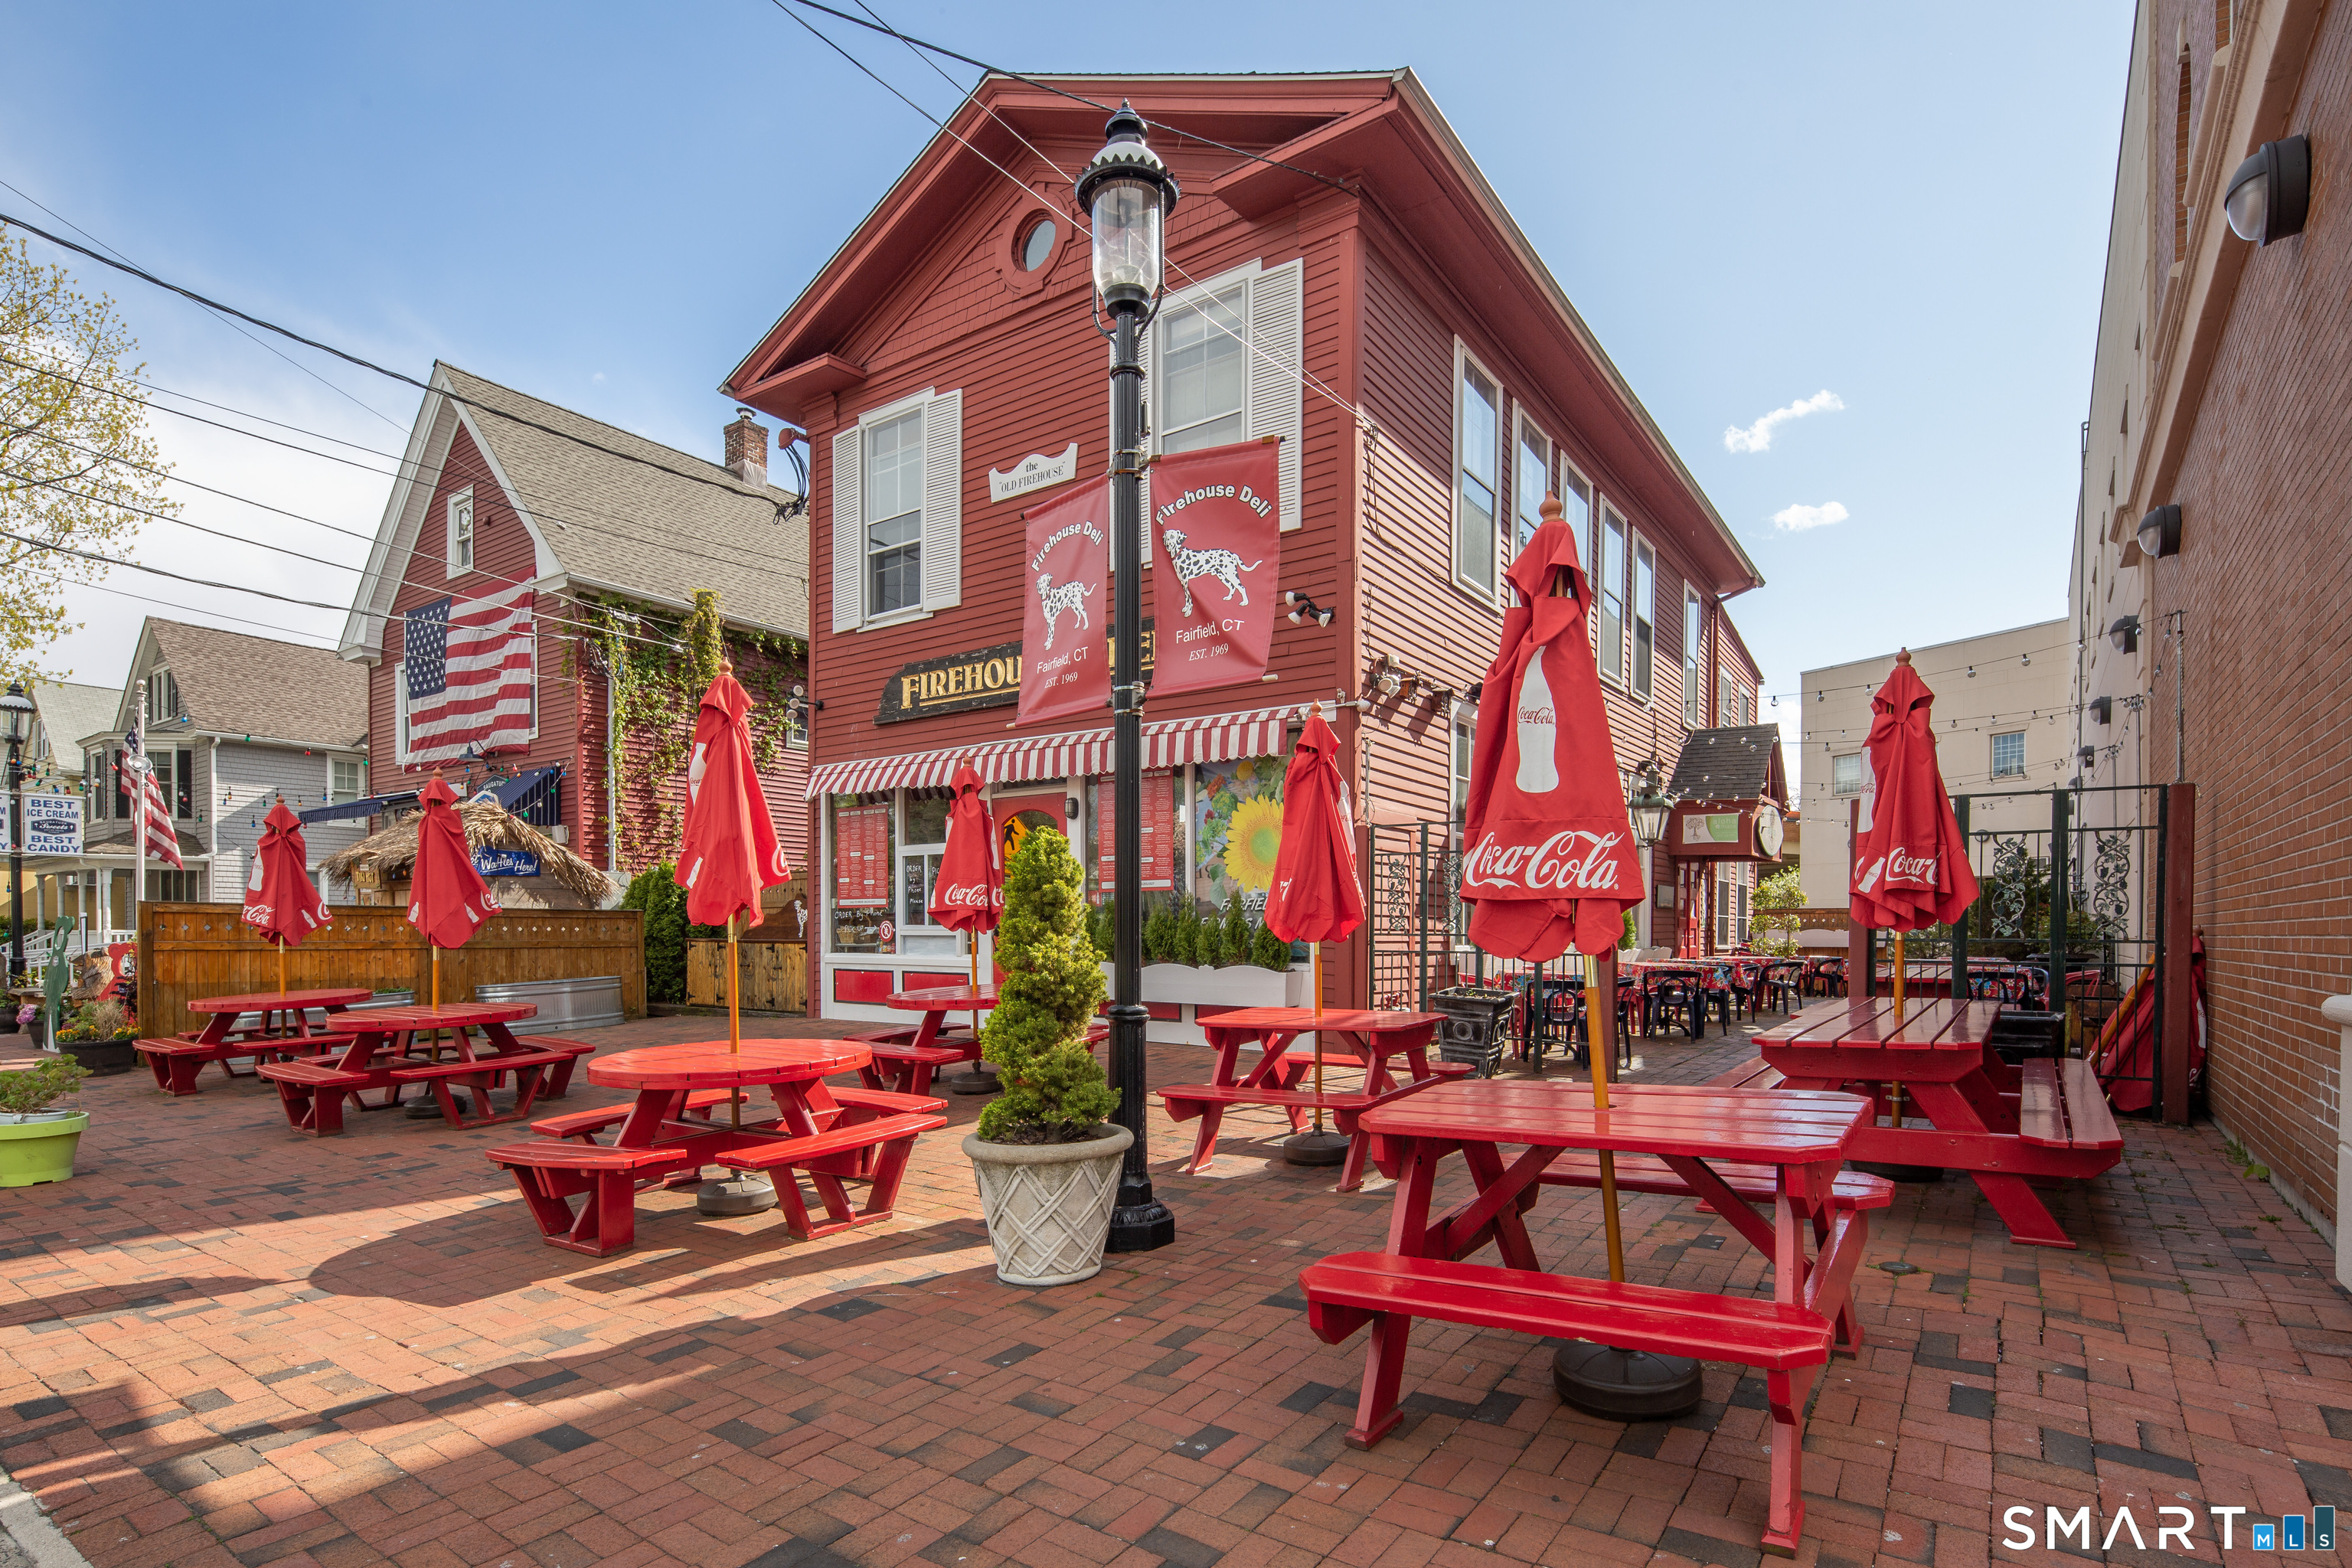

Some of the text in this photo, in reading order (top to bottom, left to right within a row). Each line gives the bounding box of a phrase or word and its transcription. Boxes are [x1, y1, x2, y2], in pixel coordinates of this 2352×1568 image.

[1026, 462, 1038, 472] the
[1155, 485, 1272, 526] Firehouse Deli
[1031, 521, 1104, 572] Firehouse Deli
[1176, 619, 1245, 644] Fairfield, CT
[1037, 652, 1071, 674] Fairfield,
[1073, 646, 1089, 662] CT
[1188, 643, 1229, 662] EST. 1969
[1044, 671, 1078, 689] EST. 1969
[1517, 707, 1555, 725] Coca-Cola
[31, 799, 75, 809] BEST
[28, 808, 78, 818] ICE CREAM
[31, 835, 75, 844] BEST
[28, 844, 80, 853] CANDY
[481, 855, 514, 870] Waffles
[514, 859, 537, 871] Here!
[835, 910, 852, 920] ORDER
[856, 910, 864, 921] By
